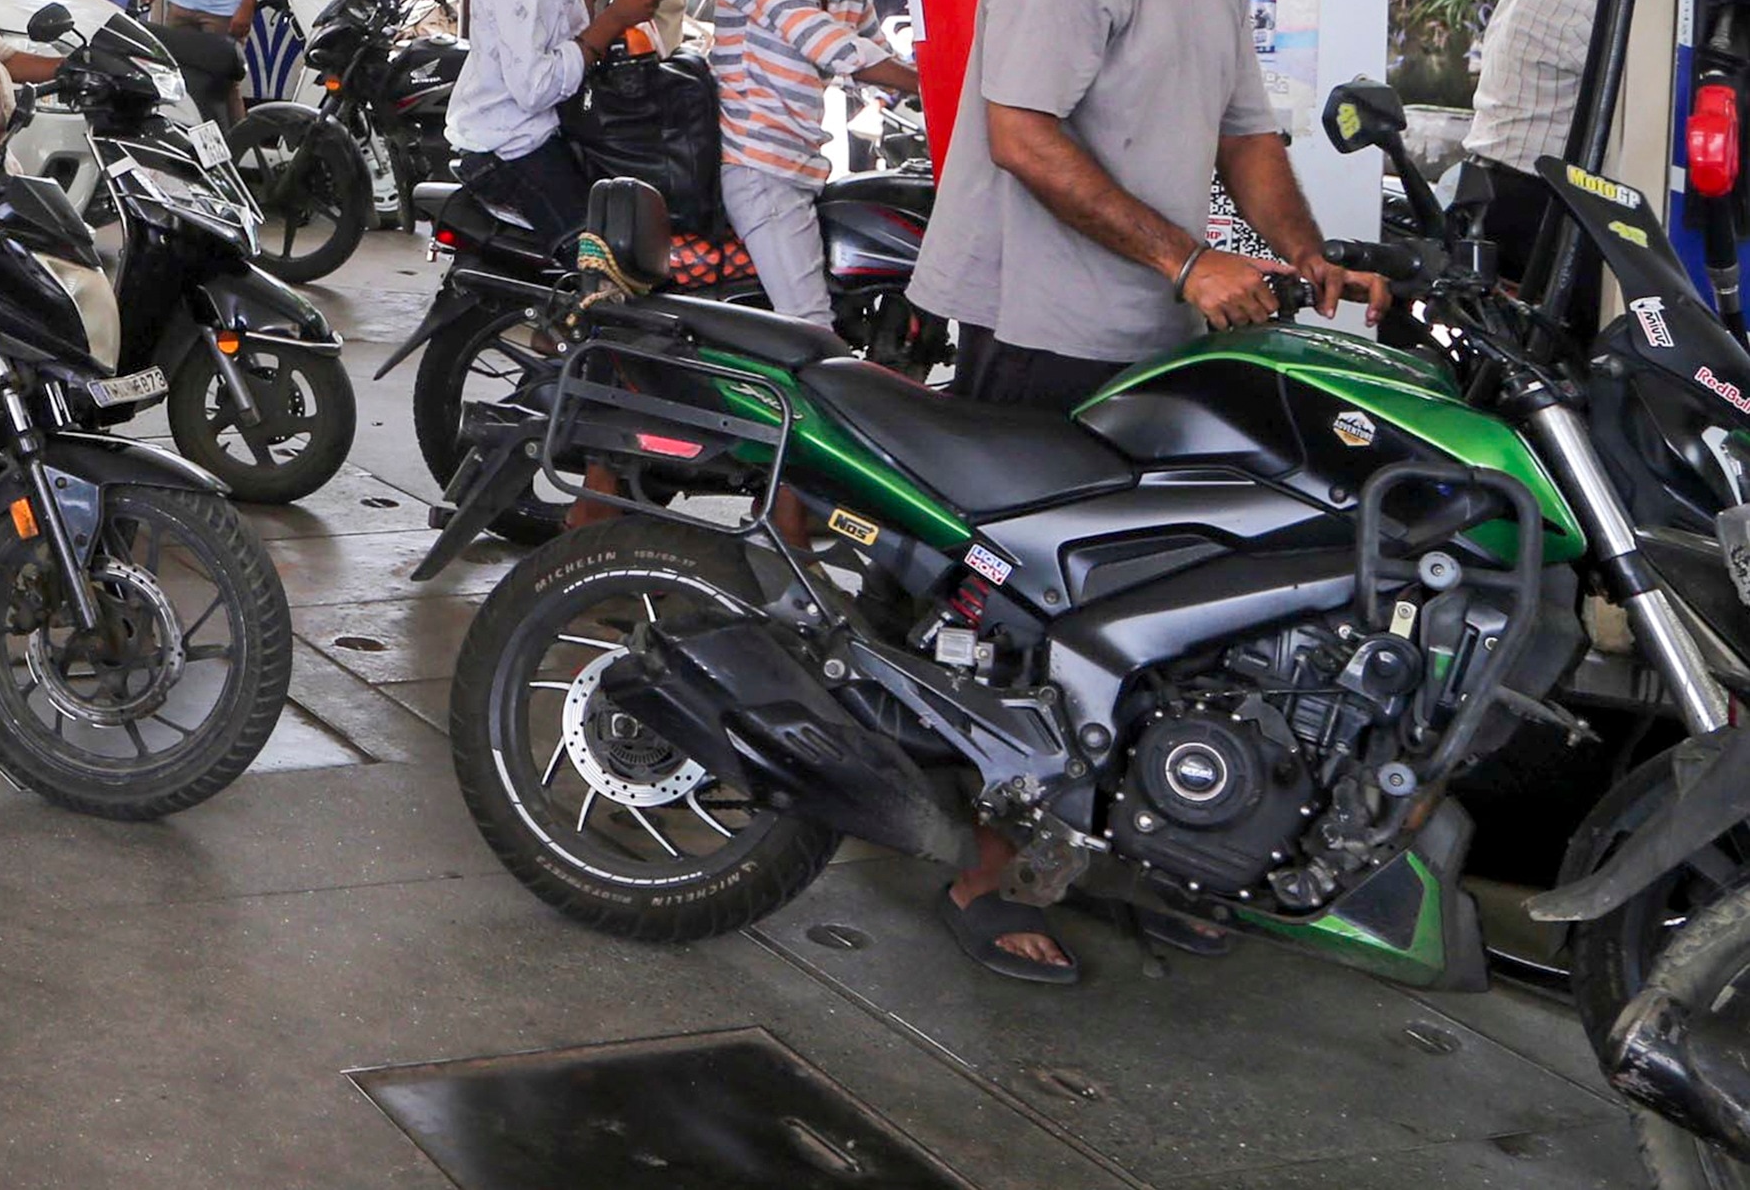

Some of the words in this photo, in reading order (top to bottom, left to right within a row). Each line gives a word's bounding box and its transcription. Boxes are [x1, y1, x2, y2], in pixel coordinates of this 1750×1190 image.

[1567, 165, 1641, 209] MotoGP
[534, 550, 617, 593] MICHELIN
[966, 556, 1004, 584] MOLY
[971, 545, 1012, 574] LIQUI
[651, 871, 741, 907] MICHELIN
